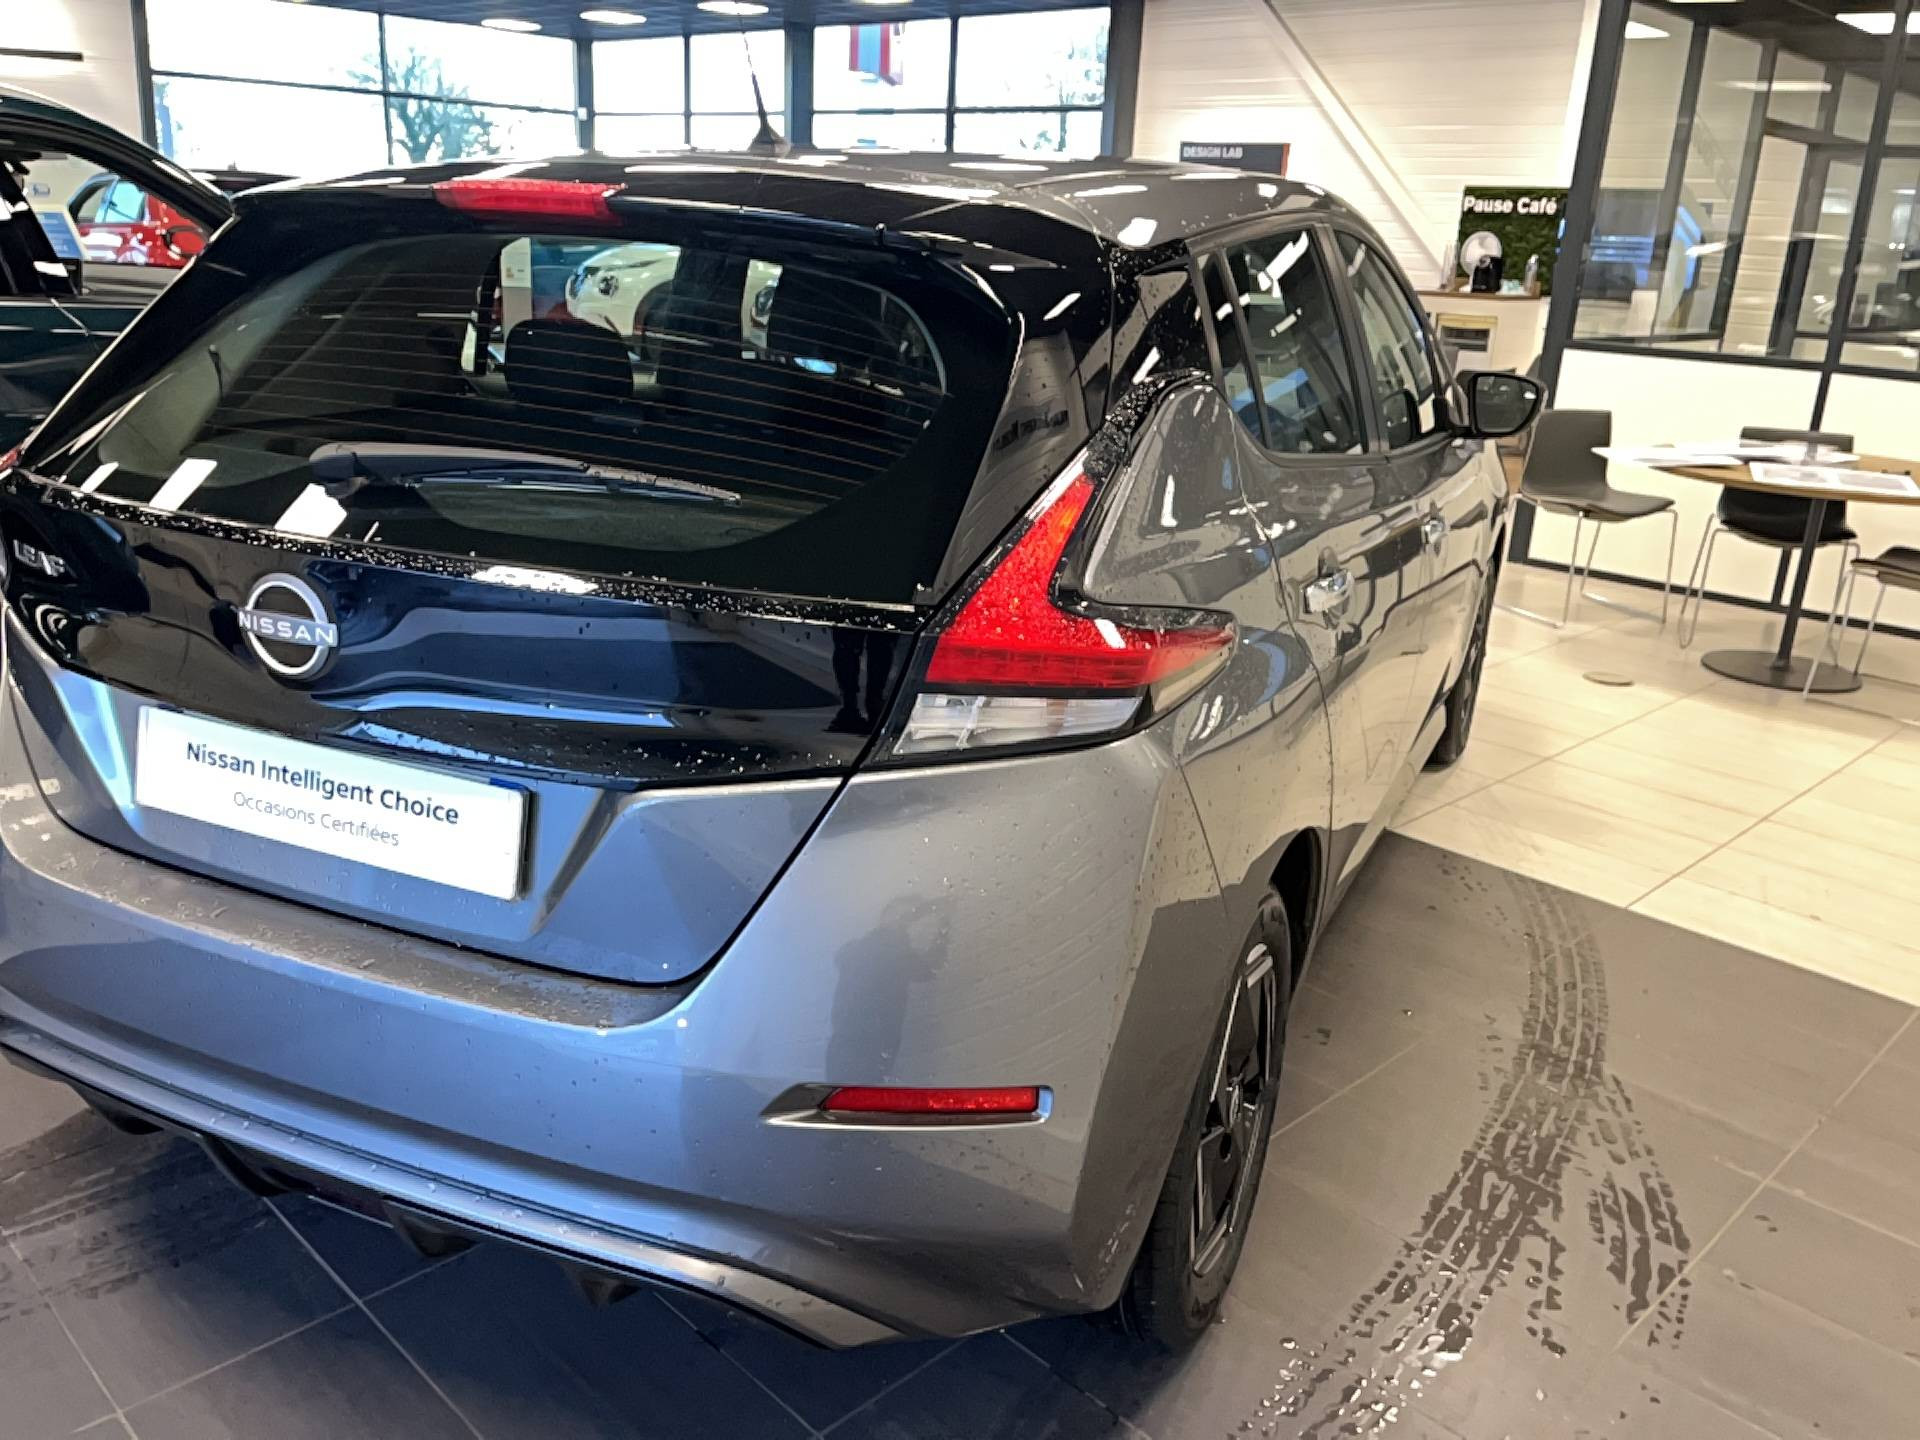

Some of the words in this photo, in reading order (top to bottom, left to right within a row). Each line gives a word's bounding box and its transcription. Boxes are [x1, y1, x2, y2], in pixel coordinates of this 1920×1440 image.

[1183, 146, 1221, 158] DESIGN
[1222, 147, 1243, 159] LAB
[1463, 194, 1514, 214] Pause
[1516, 196, 1557, 216] Café
[239, 610, 334, 643] NISSAN
[186, 741, 255, 776] Nissan
[261, 760, 373, 805] Intelligent
[380, 789, 459, 824] Choice
[233, 791, 315, 825] Occasions
[320, 813, 399, 846] Certifiées
